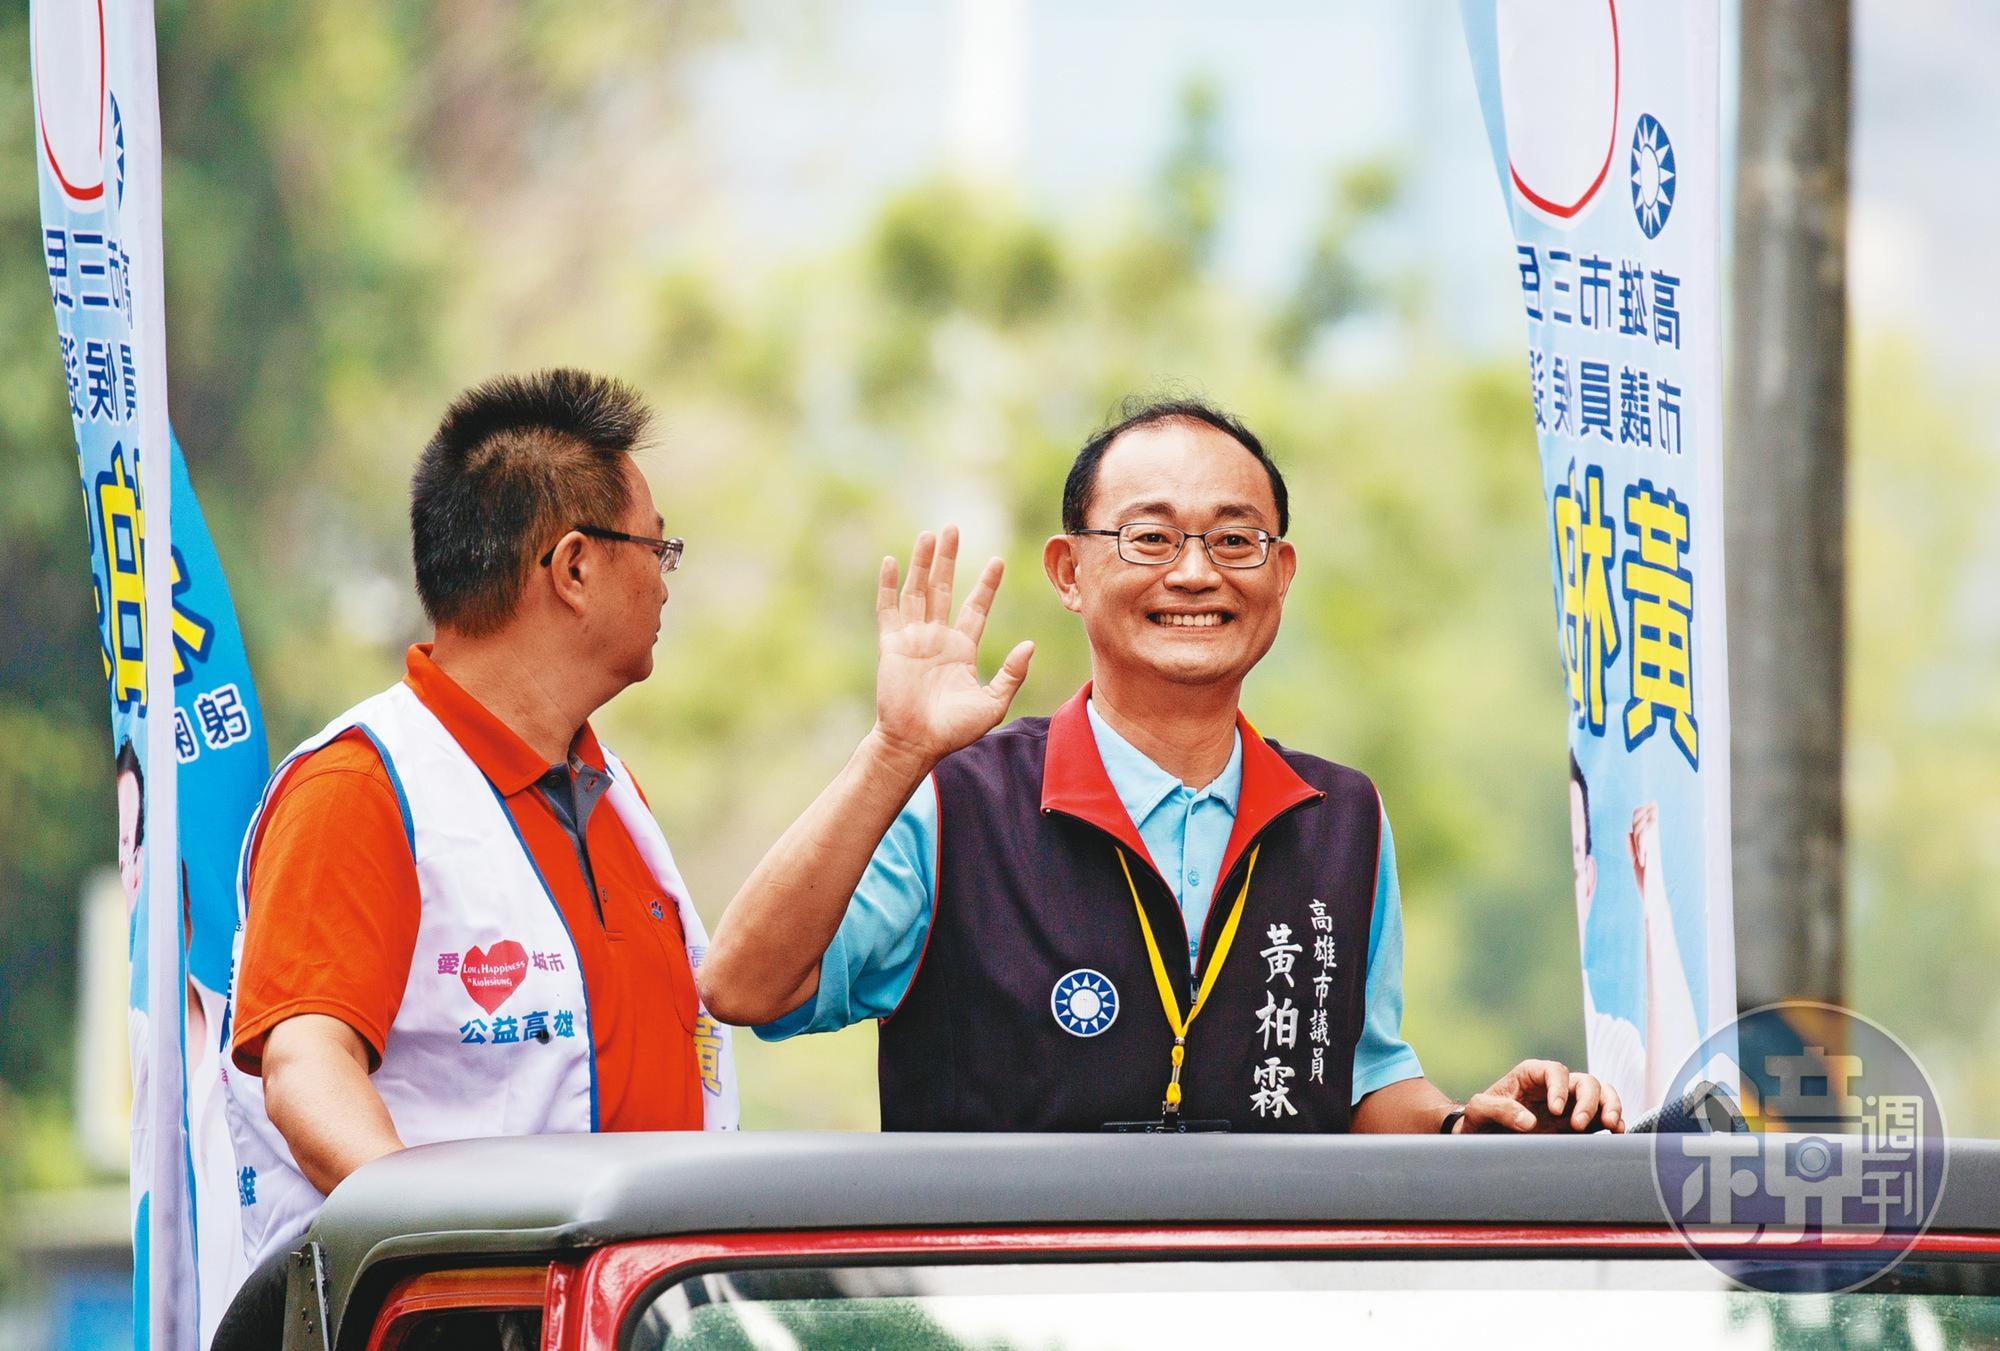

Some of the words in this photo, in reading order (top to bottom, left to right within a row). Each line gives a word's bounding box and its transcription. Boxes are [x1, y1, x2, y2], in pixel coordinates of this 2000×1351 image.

[459, 1009, 576, 1045] 公益高雄
[1250, 923, 1304, 1119] 黃柏霖
[1308, 898, 1338, 1085] 高雄市議員
